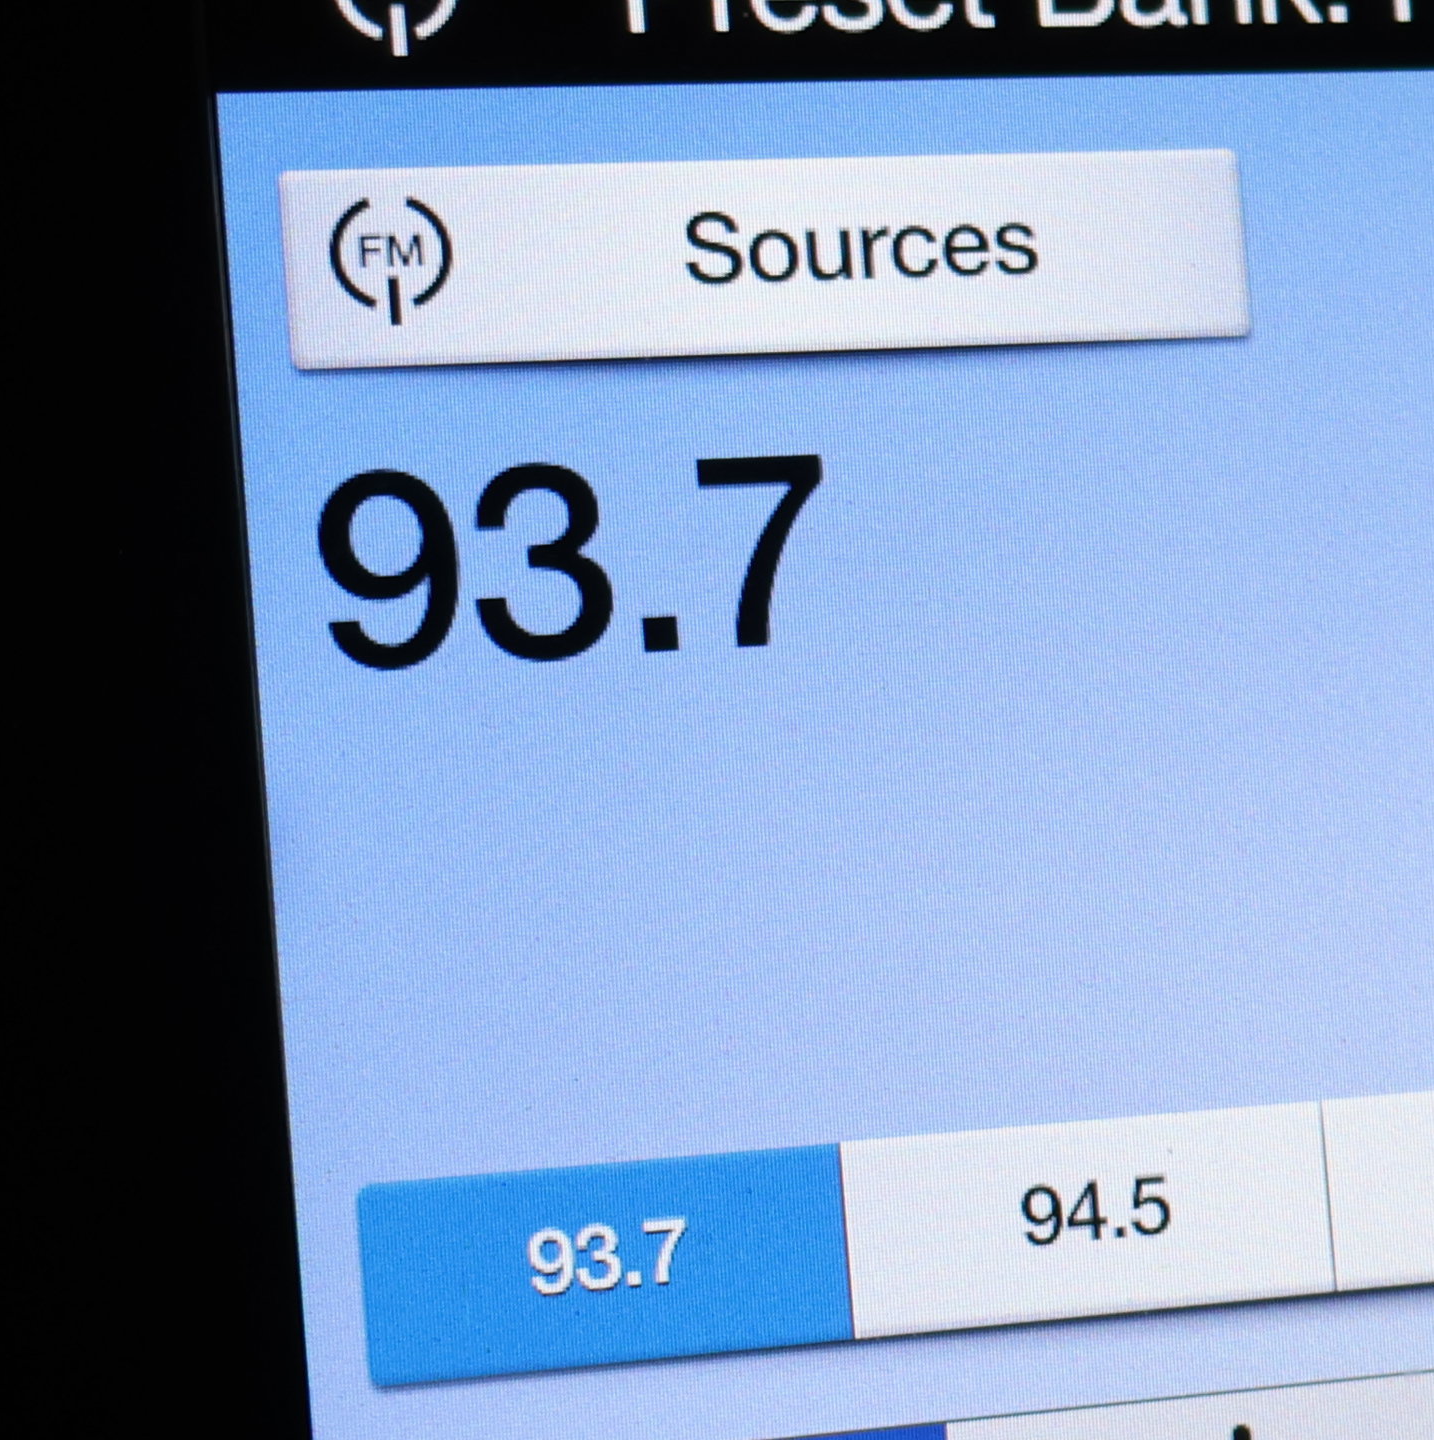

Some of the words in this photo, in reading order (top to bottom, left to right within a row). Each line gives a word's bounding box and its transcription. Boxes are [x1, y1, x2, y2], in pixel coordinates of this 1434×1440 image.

[359, 233, 425, 269] FM
[682, 208, 1040, 286] Sources
[317, 452, 824, 672] 93.7
[1019, 1176, 1172, 1246] 94.5
[526, 1218, 688, 1296] 93.7
